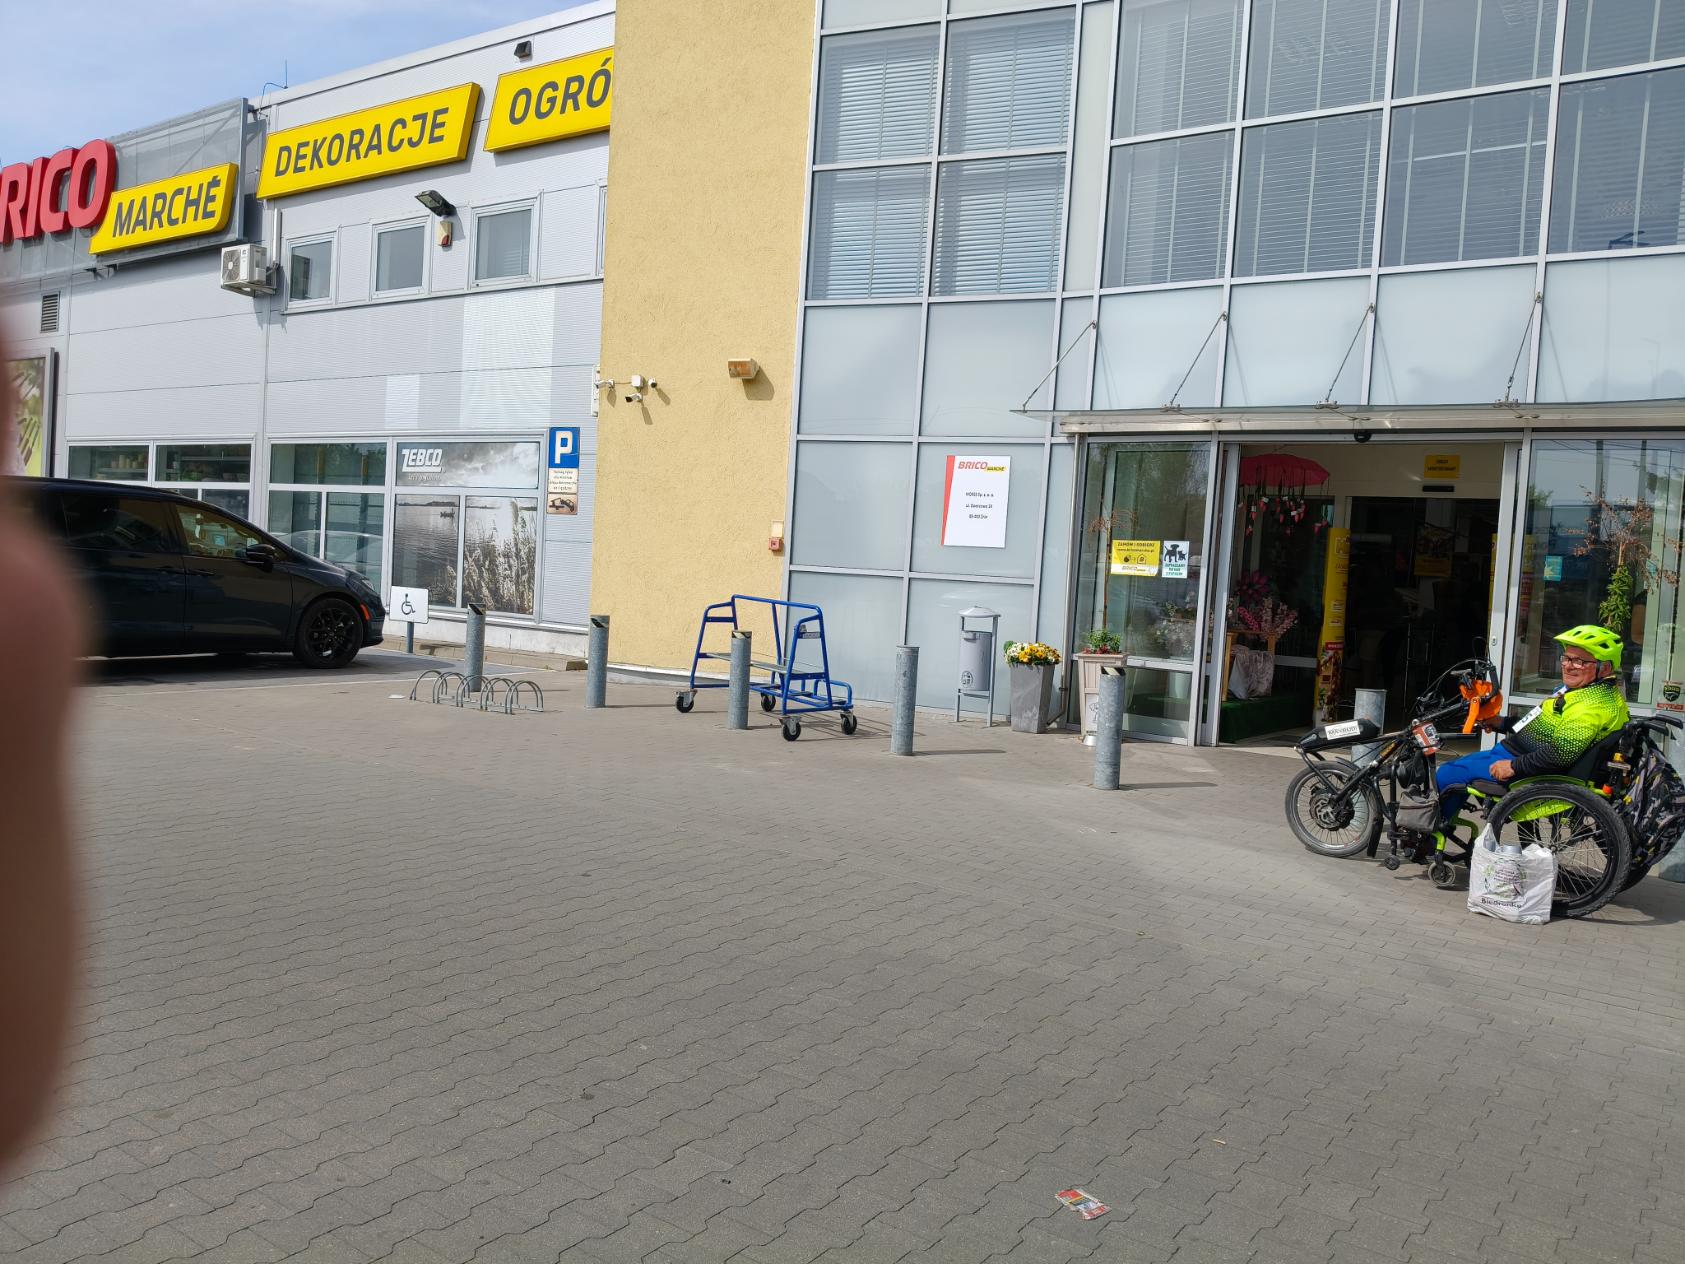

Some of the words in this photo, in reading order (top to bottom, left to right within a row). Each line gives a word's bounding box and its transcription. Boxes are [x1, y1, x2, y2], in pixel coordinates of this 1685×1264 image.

[509, 57, 612, 125] OGRÓ
[274, 107, 450, 177] DEKORACJE
[0, 139, 116, 245] RICO
[112, 175, 222, 238] MARCHÉ
[401, 448, 443, 473] ZEBCO
[554, 430, 573, 464] P
[958, 461, 988, 470] BRICO
